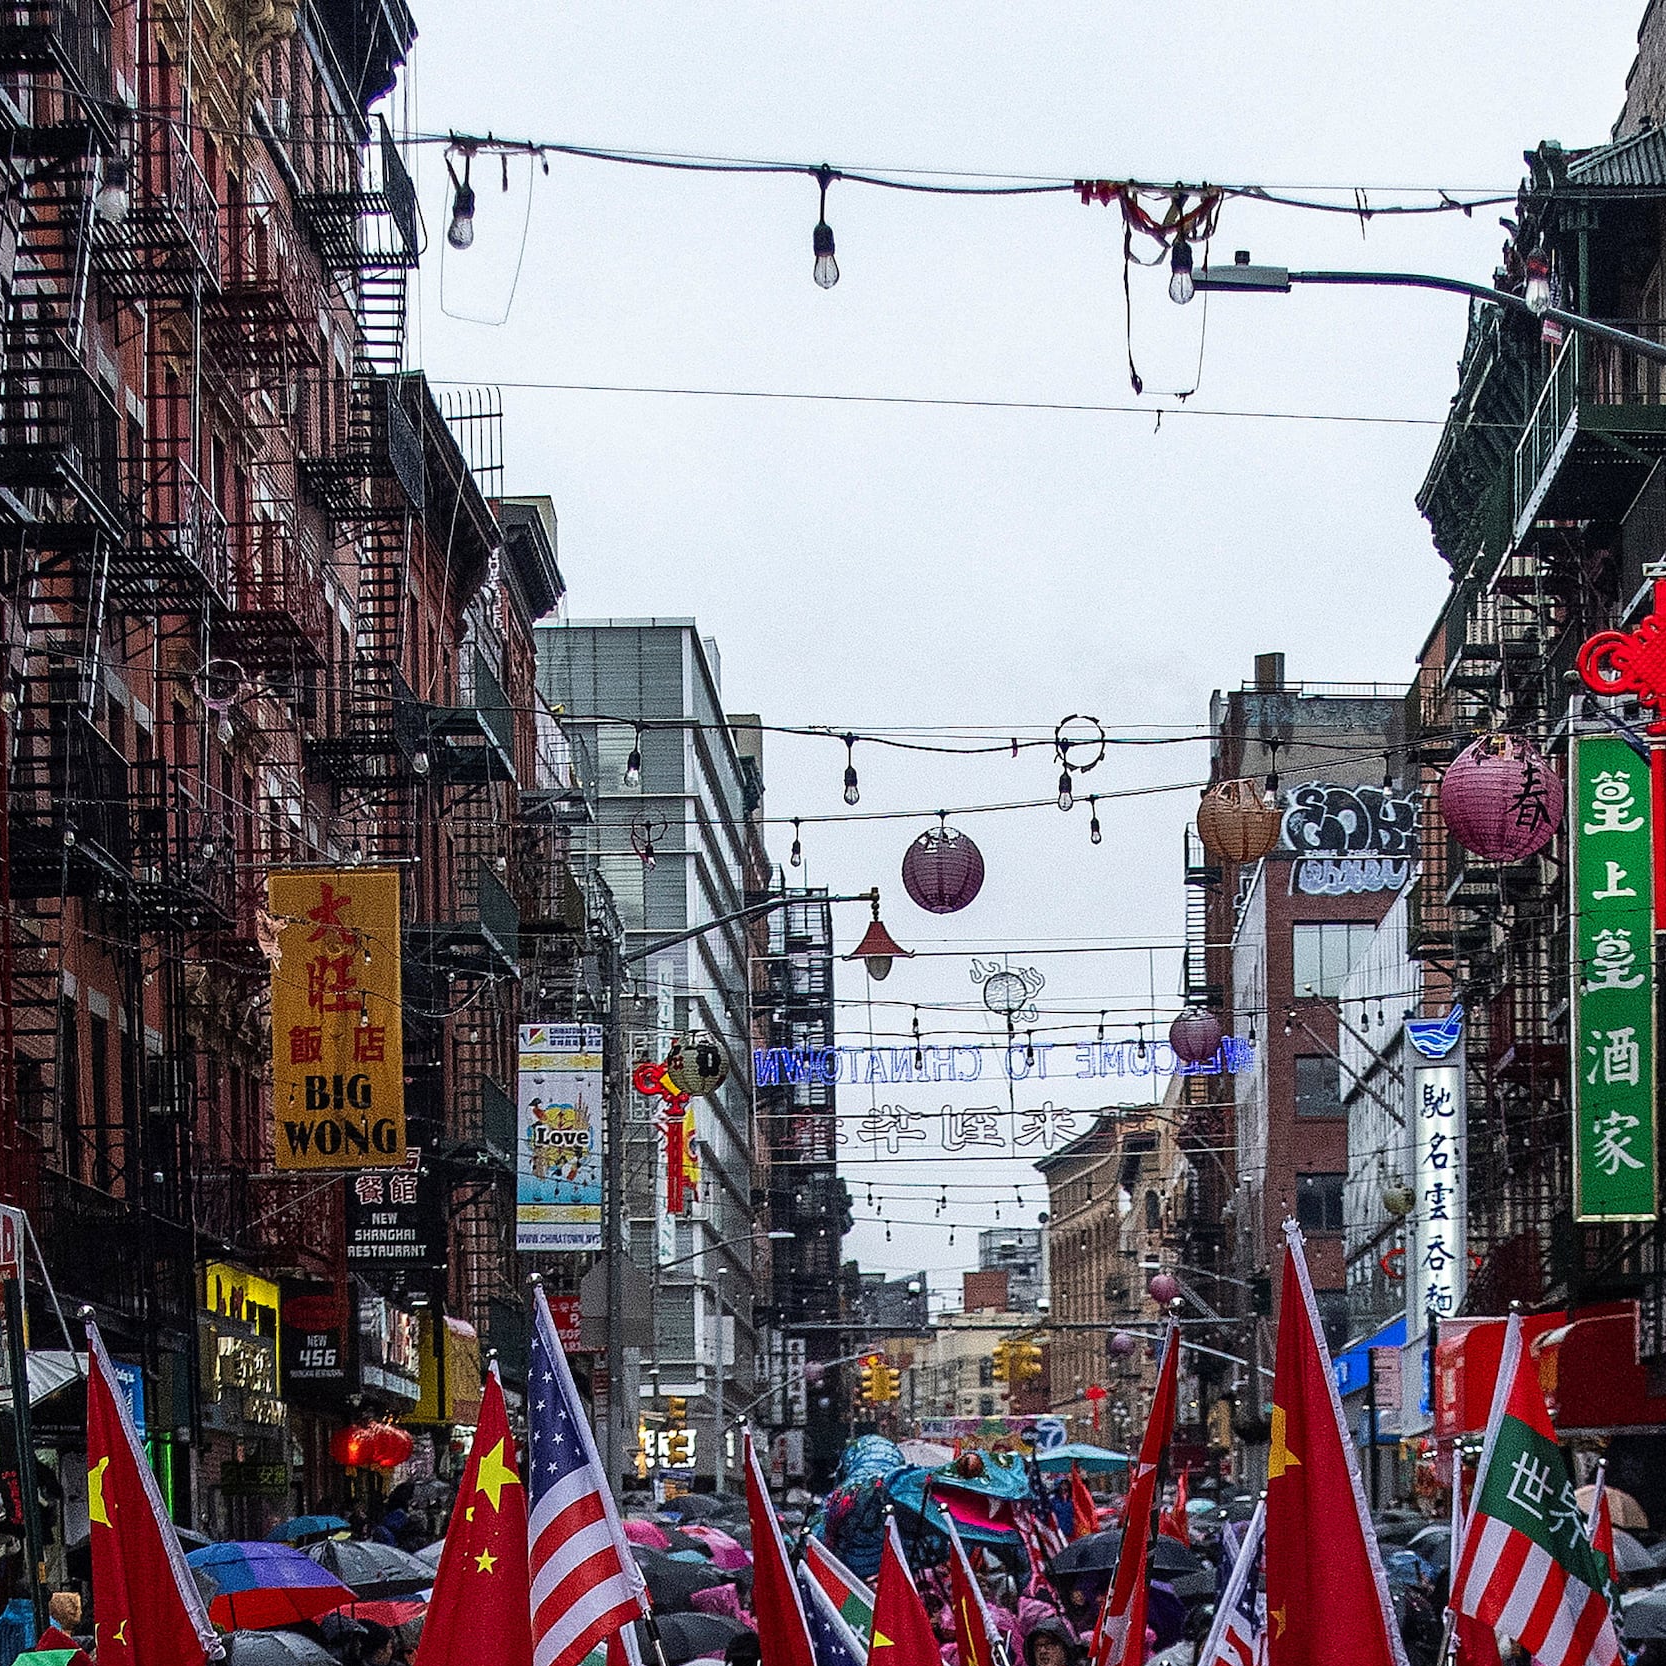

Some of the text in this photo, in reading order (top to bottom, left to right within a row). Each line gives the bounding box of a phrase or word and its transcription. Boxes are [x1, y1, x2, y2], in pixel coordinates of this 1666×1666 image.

[1504, 759, 1552, 832] 春
[307, 882, 362, 1018] 大旺
[289, 1025, 386, 1065] 飯店
[304, 1074, 373, 1112] BIG
[283, 1118, 398, 1157] WONG
[535, 1127, 589, 1148] Love
[372, 1212, 398, 1225] NEW
[354, 1229, 416, 1242] SHANGHAI
[347, 1245, 428, 1258] RESTAURANT
[307, 1335, 327, 1347] NEW
[299, 1348, 337, 1367] 456
